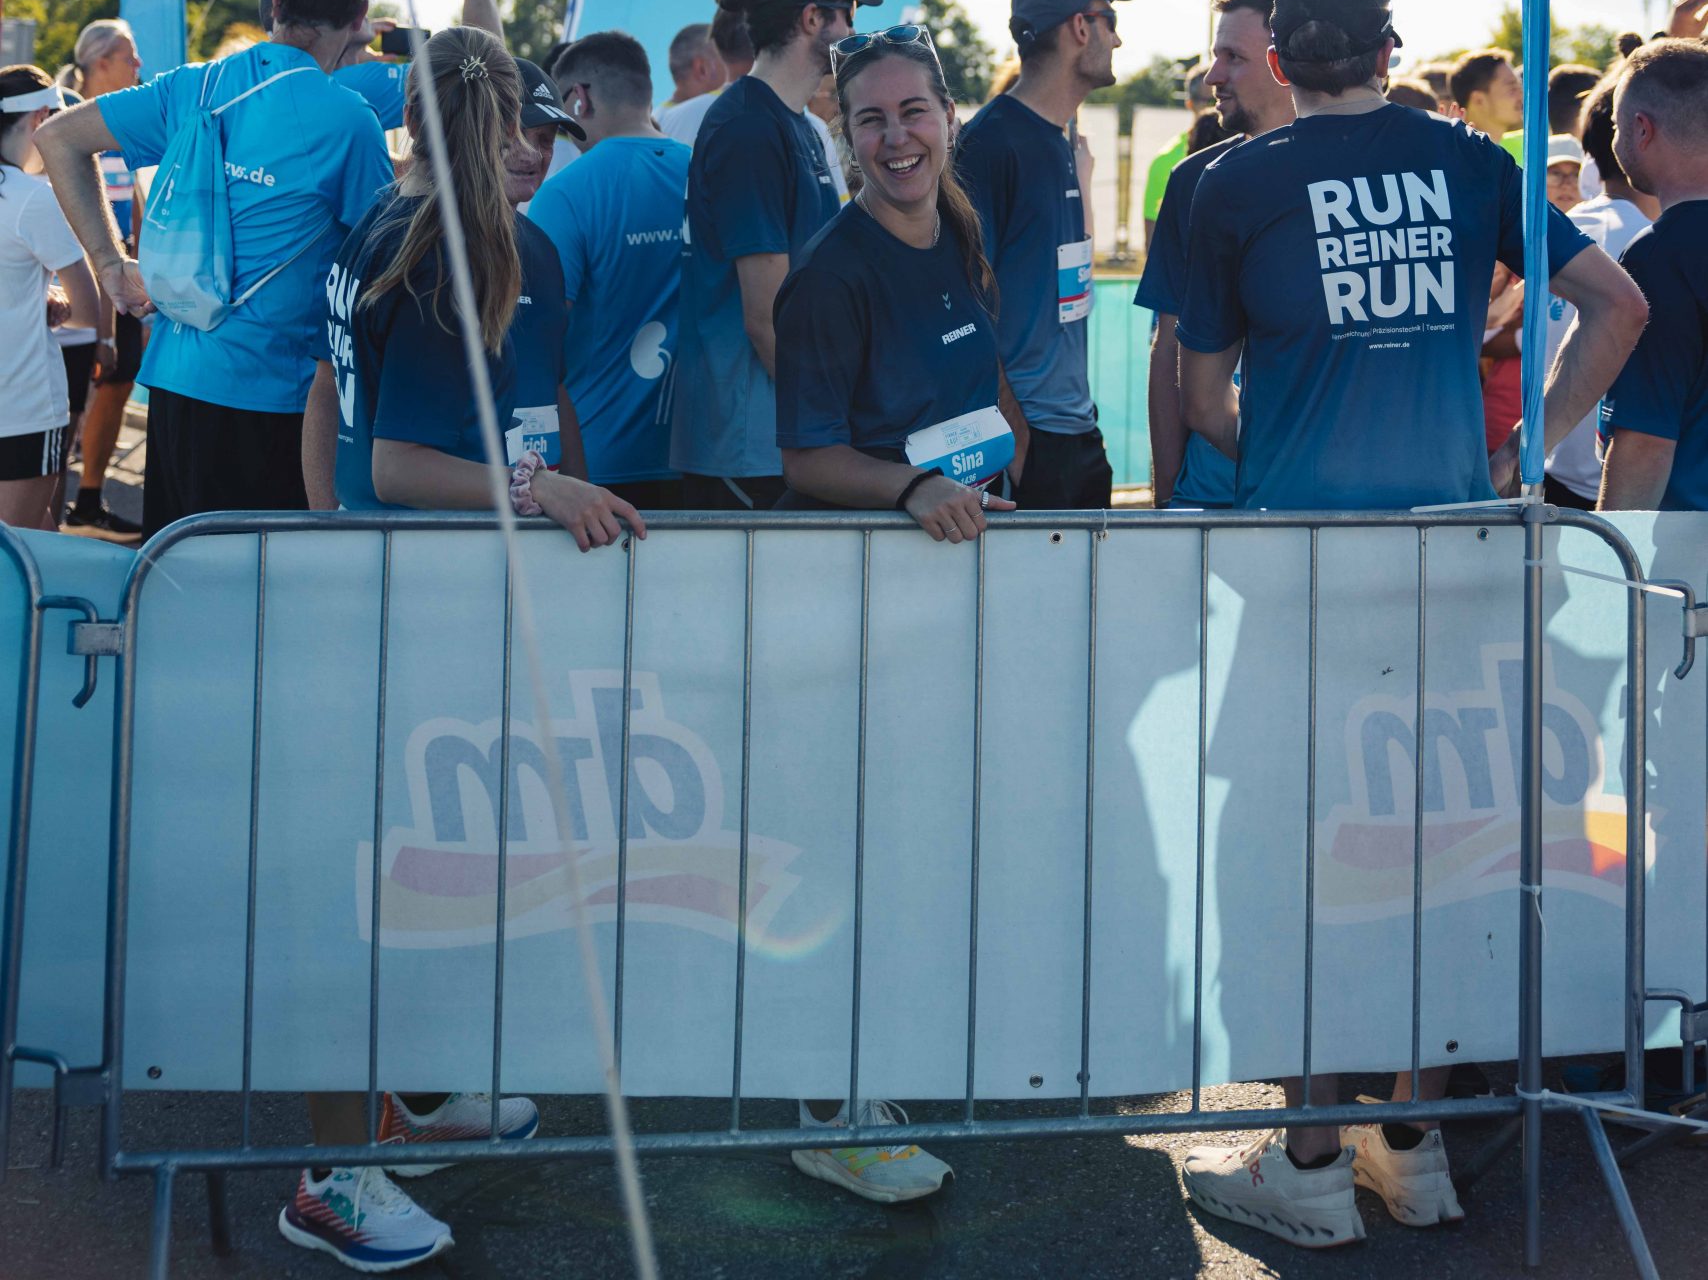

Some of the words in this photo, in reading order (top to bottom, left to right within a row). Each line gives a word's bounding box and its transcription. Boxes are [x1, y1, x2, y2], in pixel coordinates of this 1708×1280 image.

[1307, 170, 1452, 234] RUN
[1317, 226, 1453, 269] REINER
[1322, 261, 1455, 324] RUN
[941, 323, 976, 345] REINER
[1426, 323, 1455, 332] Teamgeist
[1368, 342, 1410, 350] www.reiner.de
[952, 450, 984, 476] Sina
